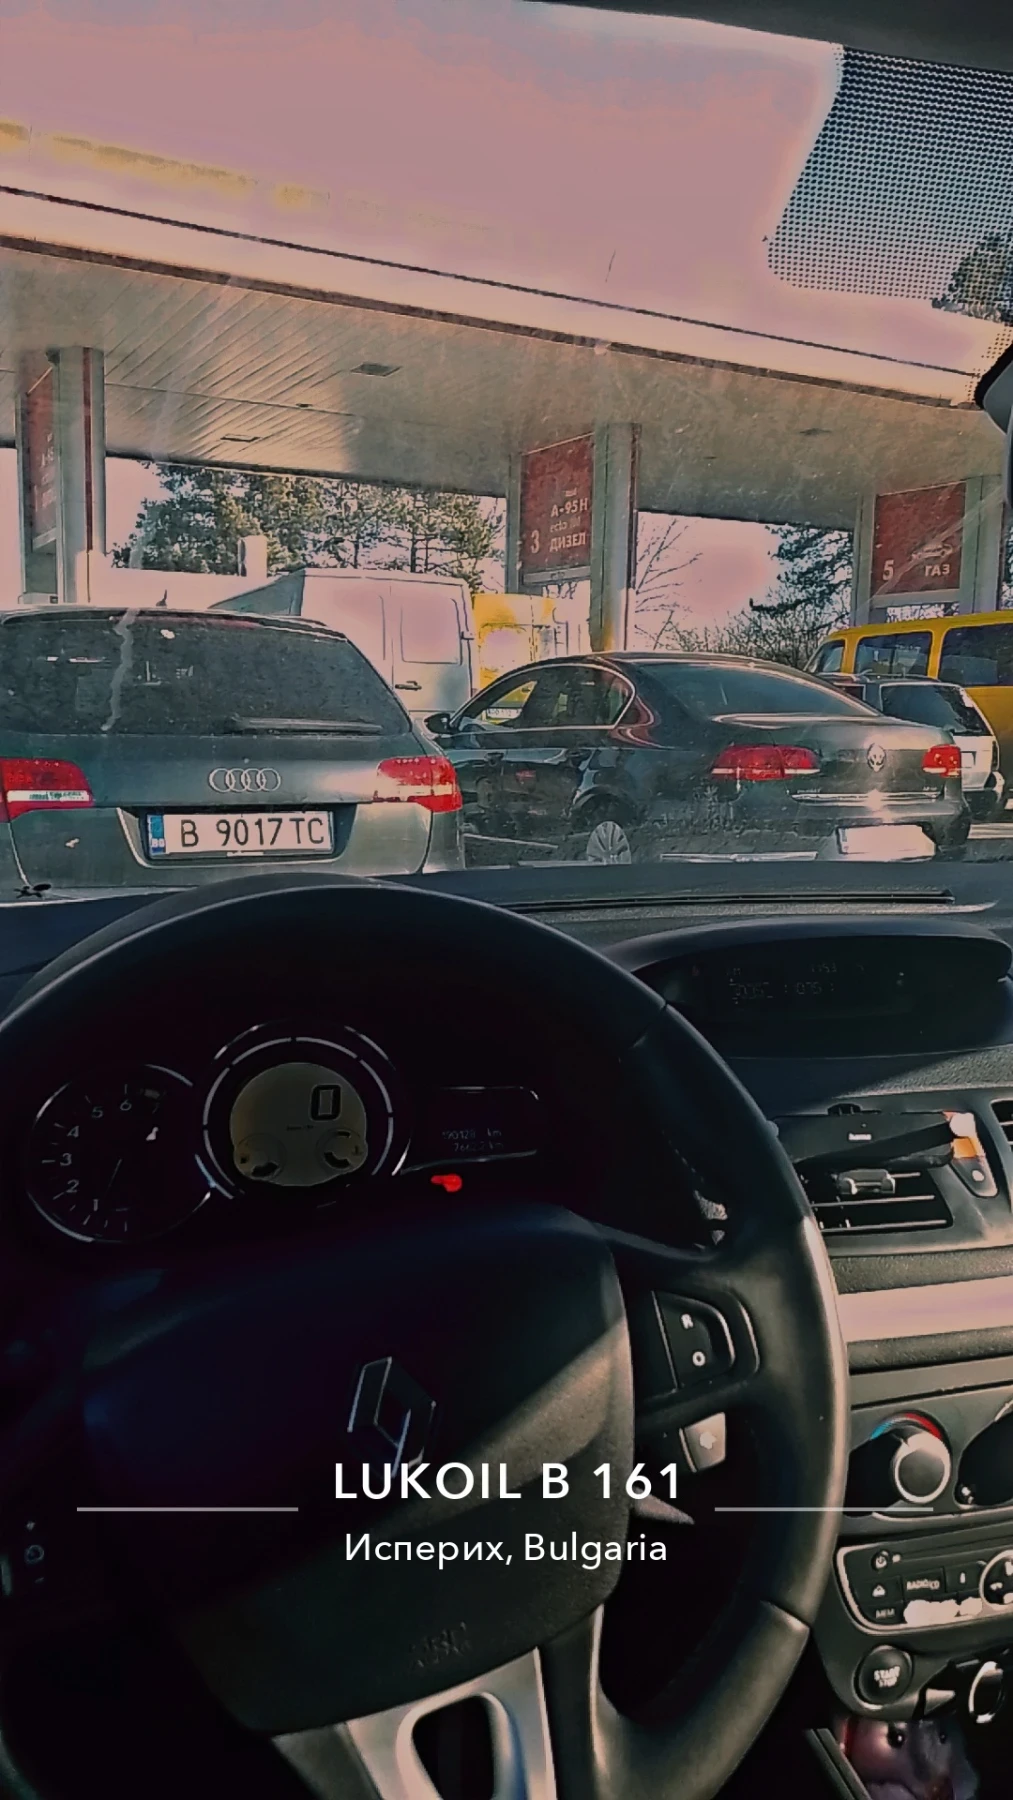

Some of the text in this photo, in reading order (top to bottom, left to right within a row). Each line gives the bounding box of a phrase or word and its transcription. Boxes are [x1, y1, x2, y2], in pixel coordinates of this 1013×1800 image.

[530, 530, 540, 554] 3
[549, 531, 586, 553] ДИЗЕЛ
[882, 559, 894, 581] 5
[924, 563, 951, 577] ГАЗ
[181, 819, 198, 847] B
[91, 1105, 104, 1118] 5
[119, 1099, 132, 1111] 6
[66, 1125, 80, 1138] 4
[59, 1152, 72, 1166] 3
[66, 1179, 79, 1193] 2
